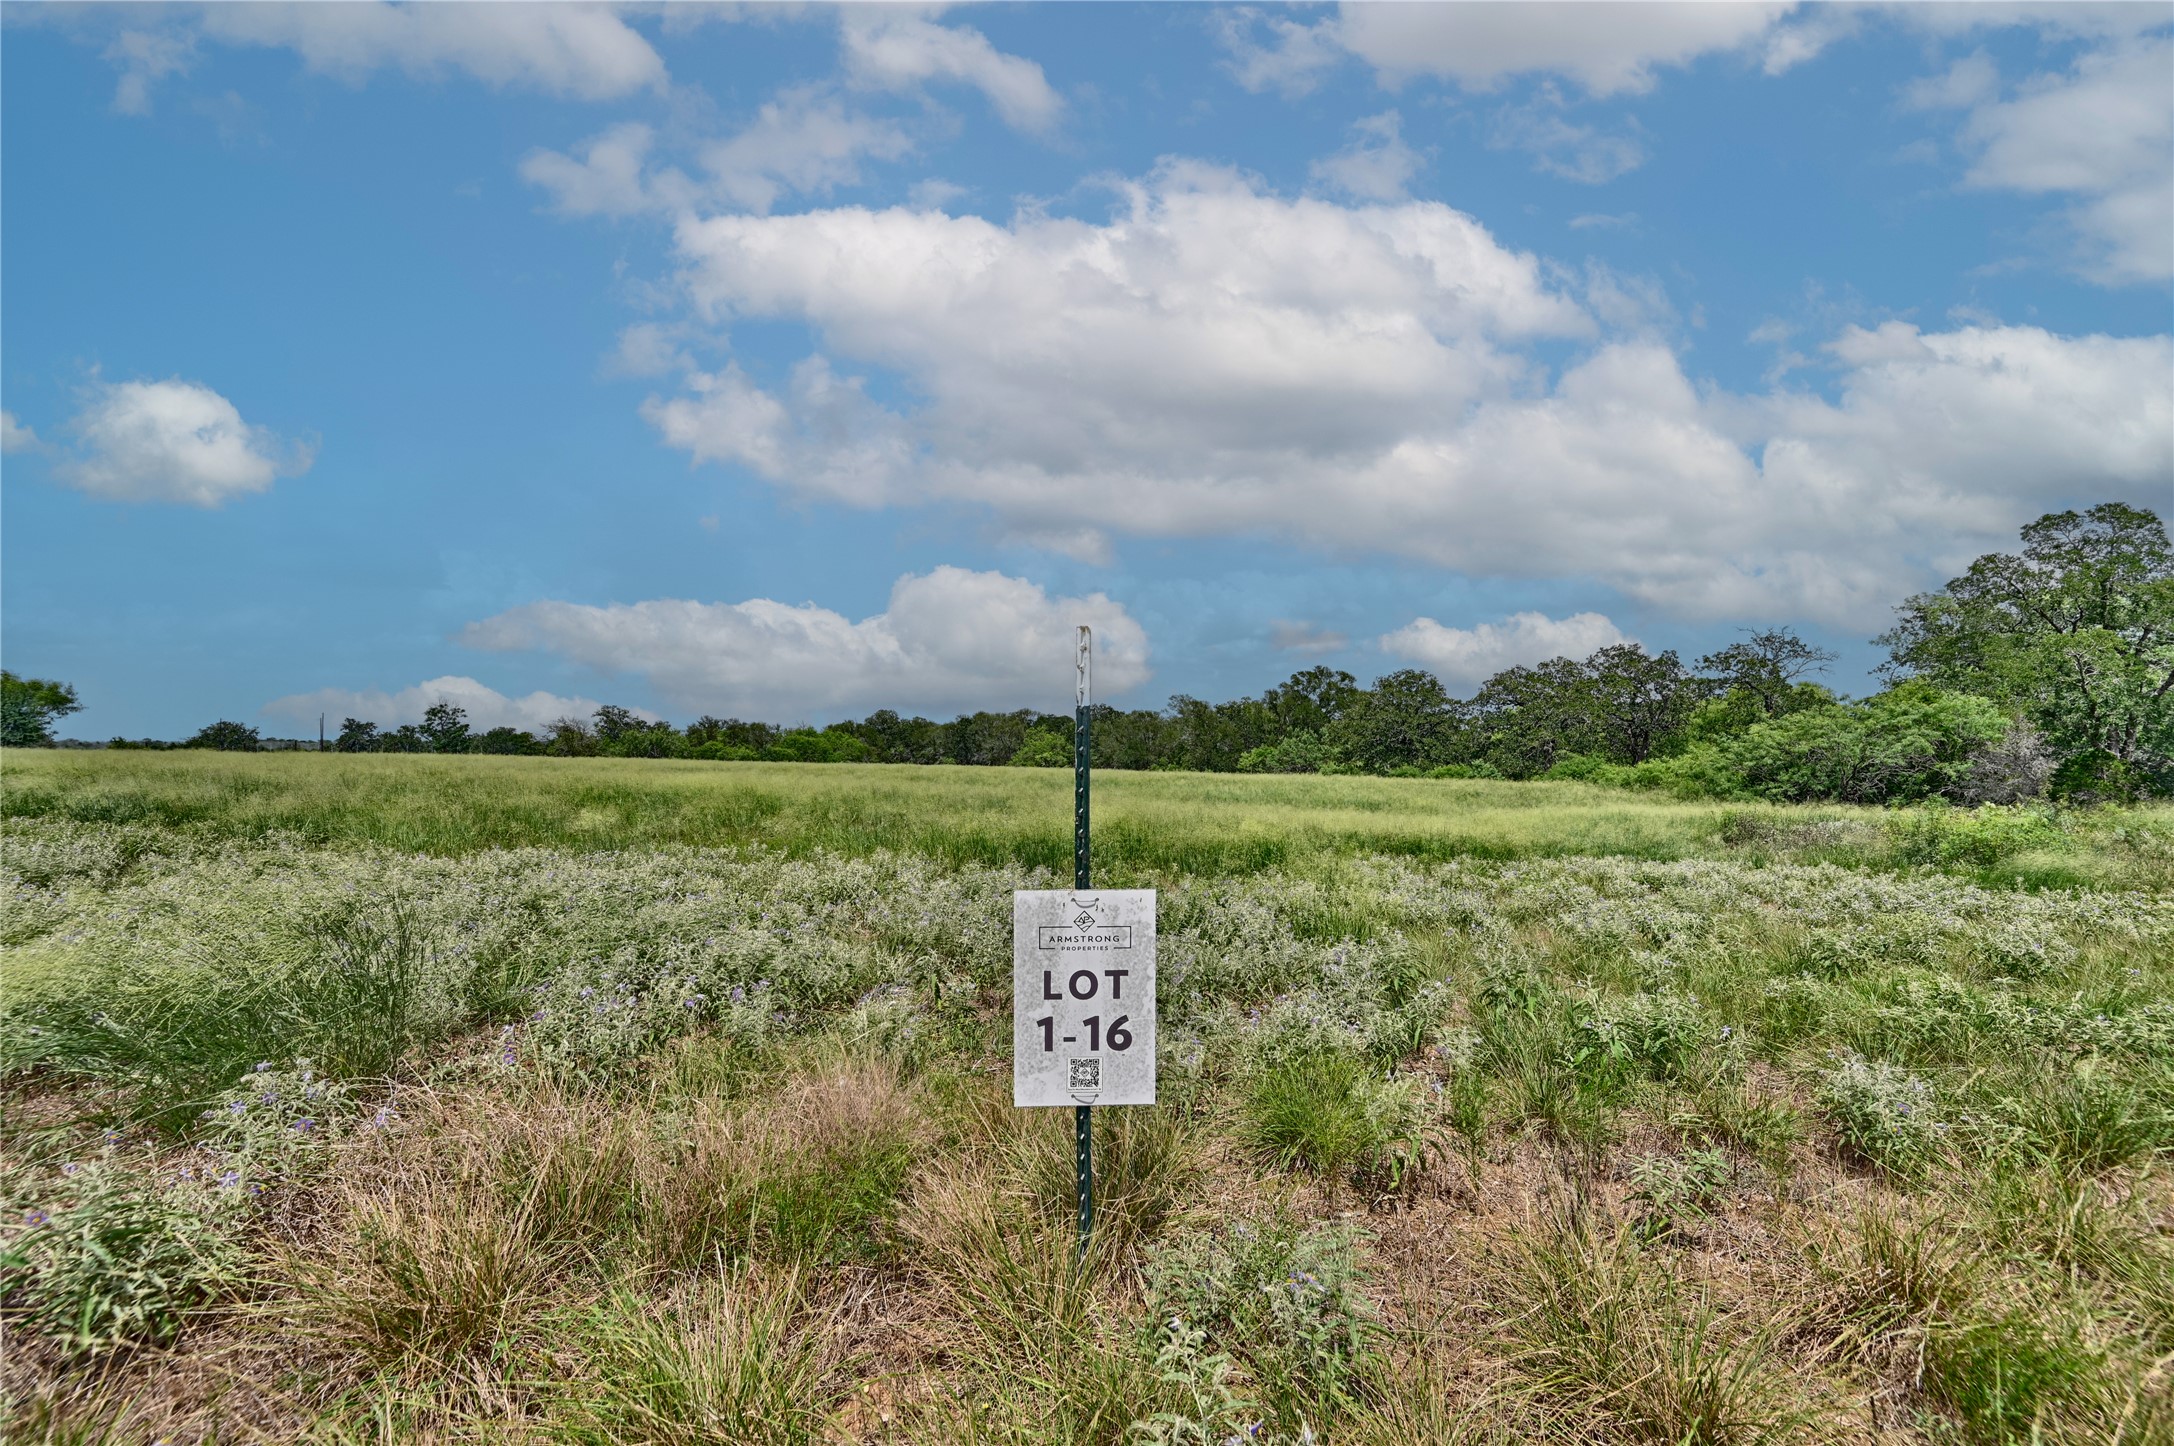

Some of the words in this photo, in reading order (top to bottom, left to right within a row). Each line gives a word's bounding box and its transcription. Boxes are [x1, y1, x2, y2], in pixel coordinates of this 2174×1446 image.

[1049, 935, 1120, 943] ARMSTRONG
[1043, 969, 1129, 1000] LOT
[1036, 1014, 1133, 1052] 1-16
